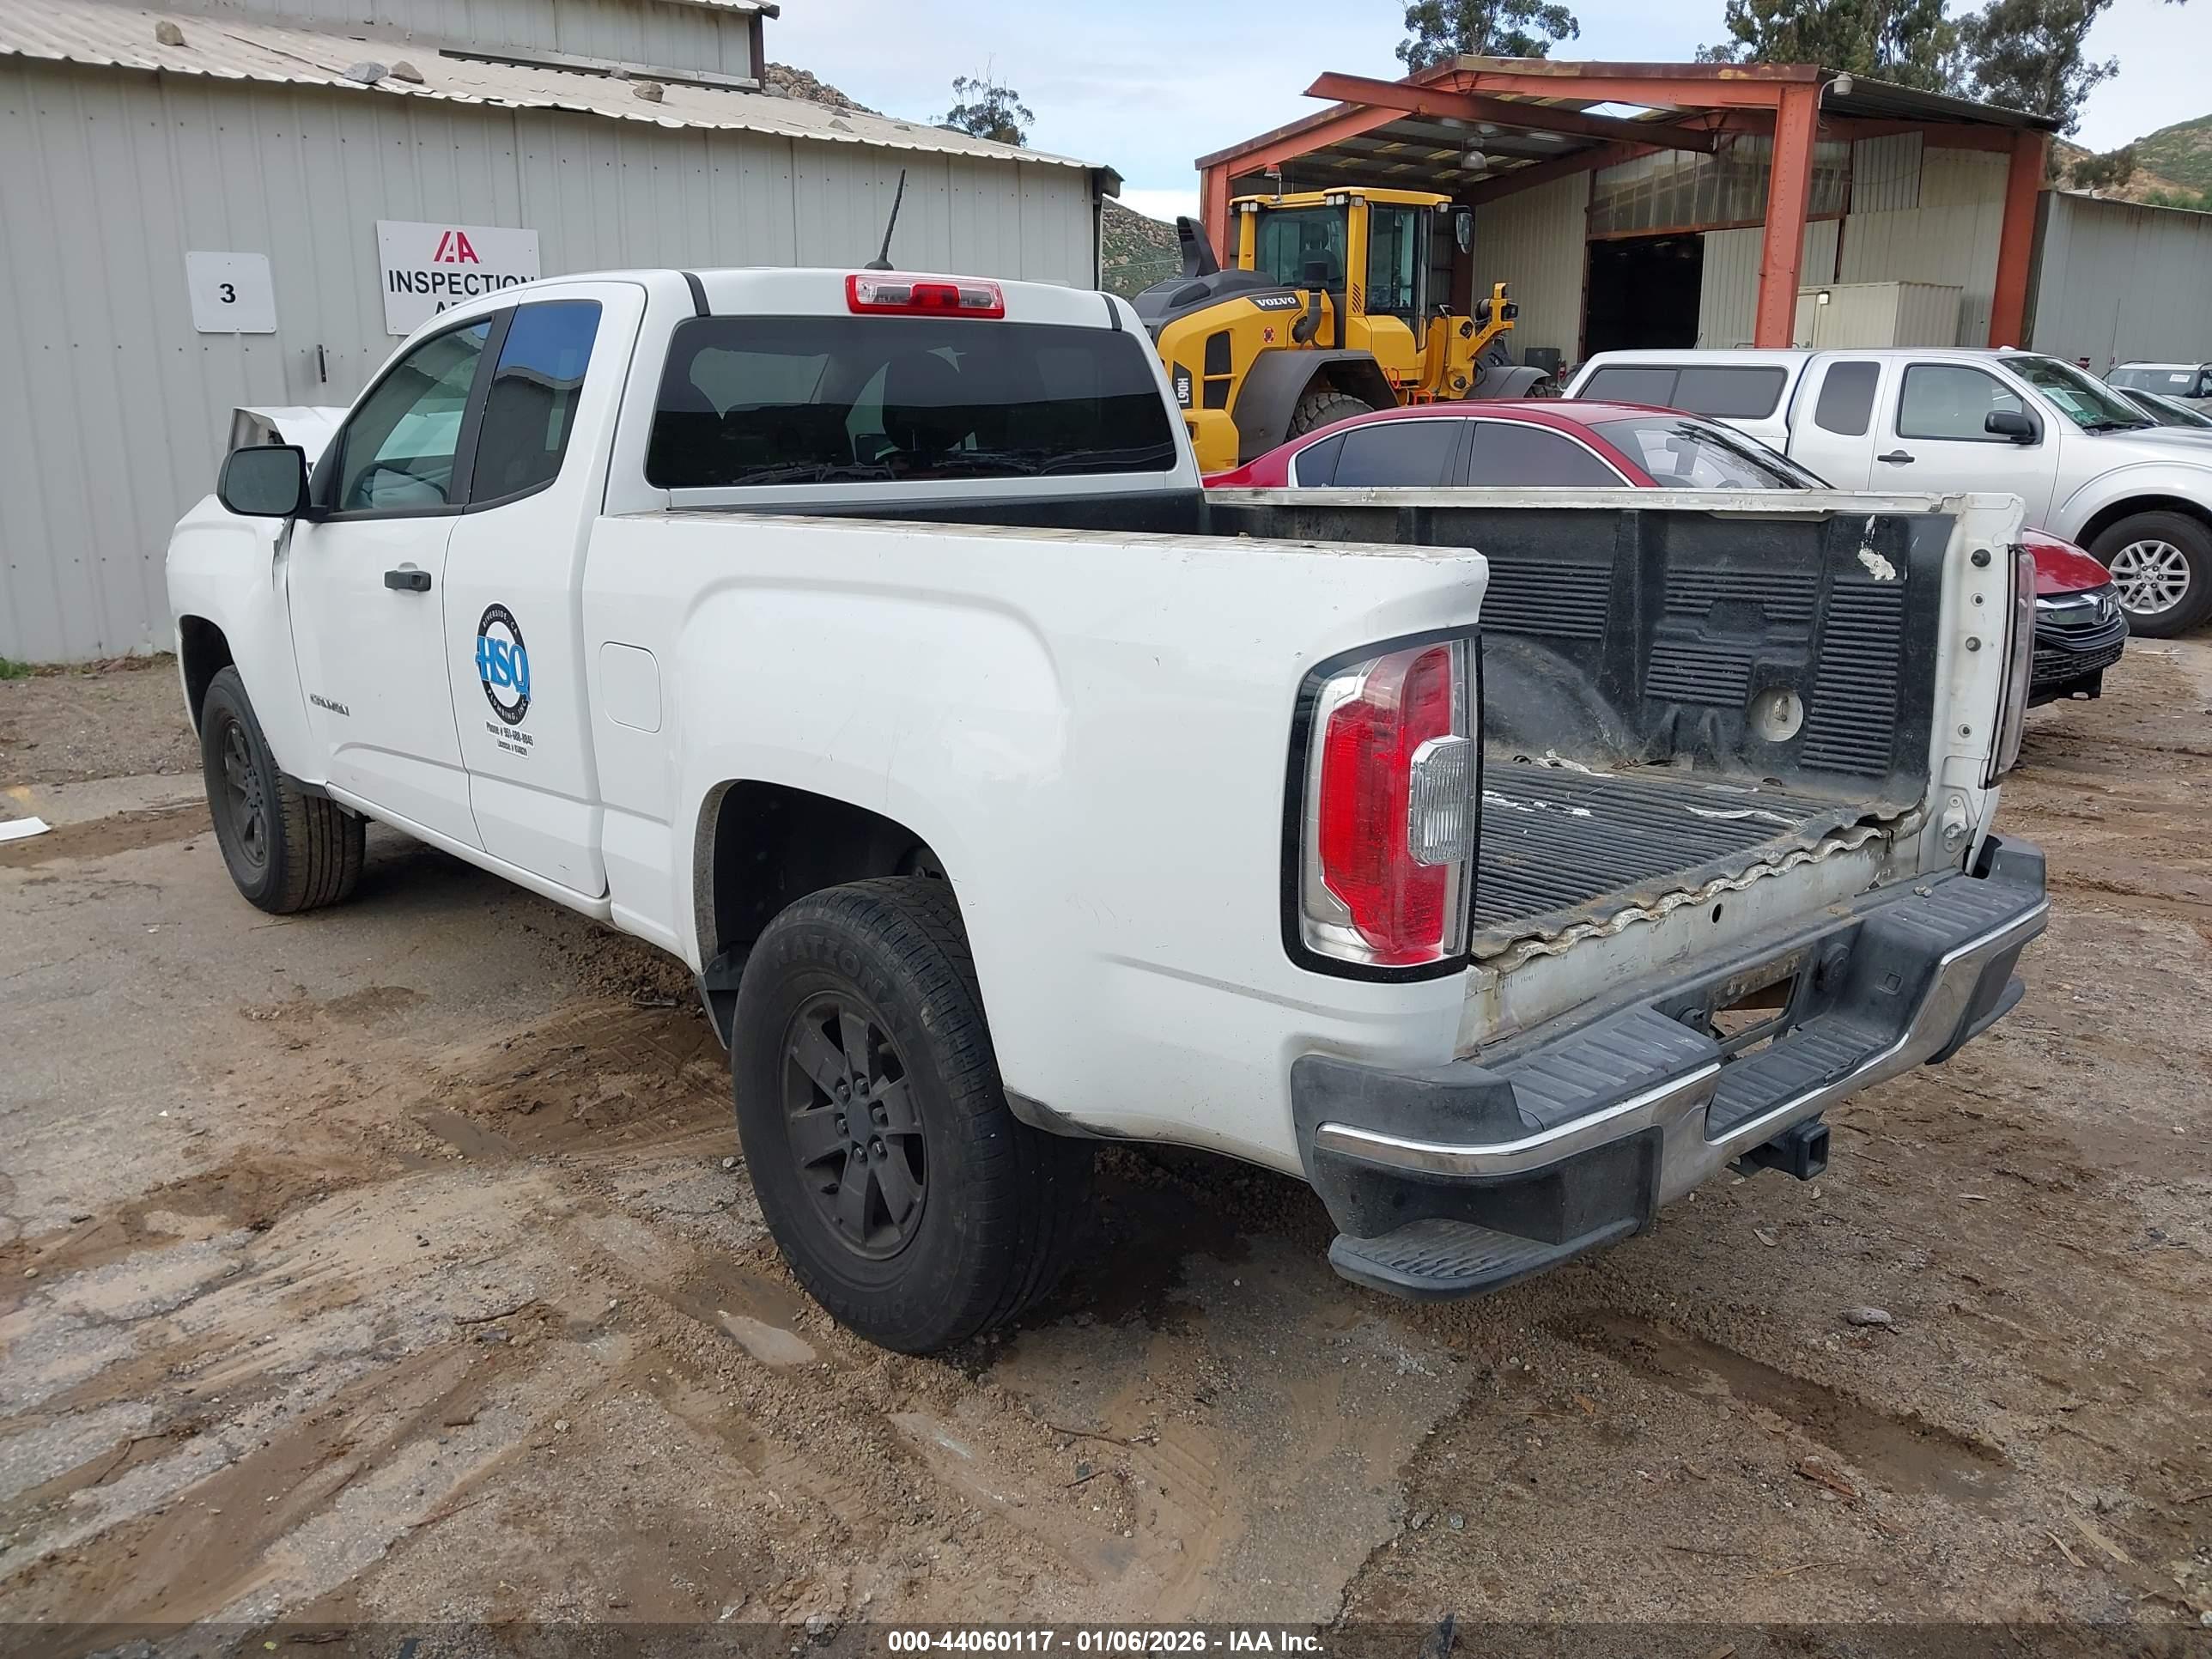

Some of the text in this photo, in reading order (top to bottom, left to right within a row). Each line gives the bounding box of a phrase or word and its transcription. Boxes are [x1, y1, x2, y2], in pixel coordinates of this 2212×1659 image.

[219, 283, 236, 303] 3
[1255, 296, 1297, 307] VOLVO
[1177, 378, 1189, 404] L90H
[474, 635, 532, 704] HSQ
